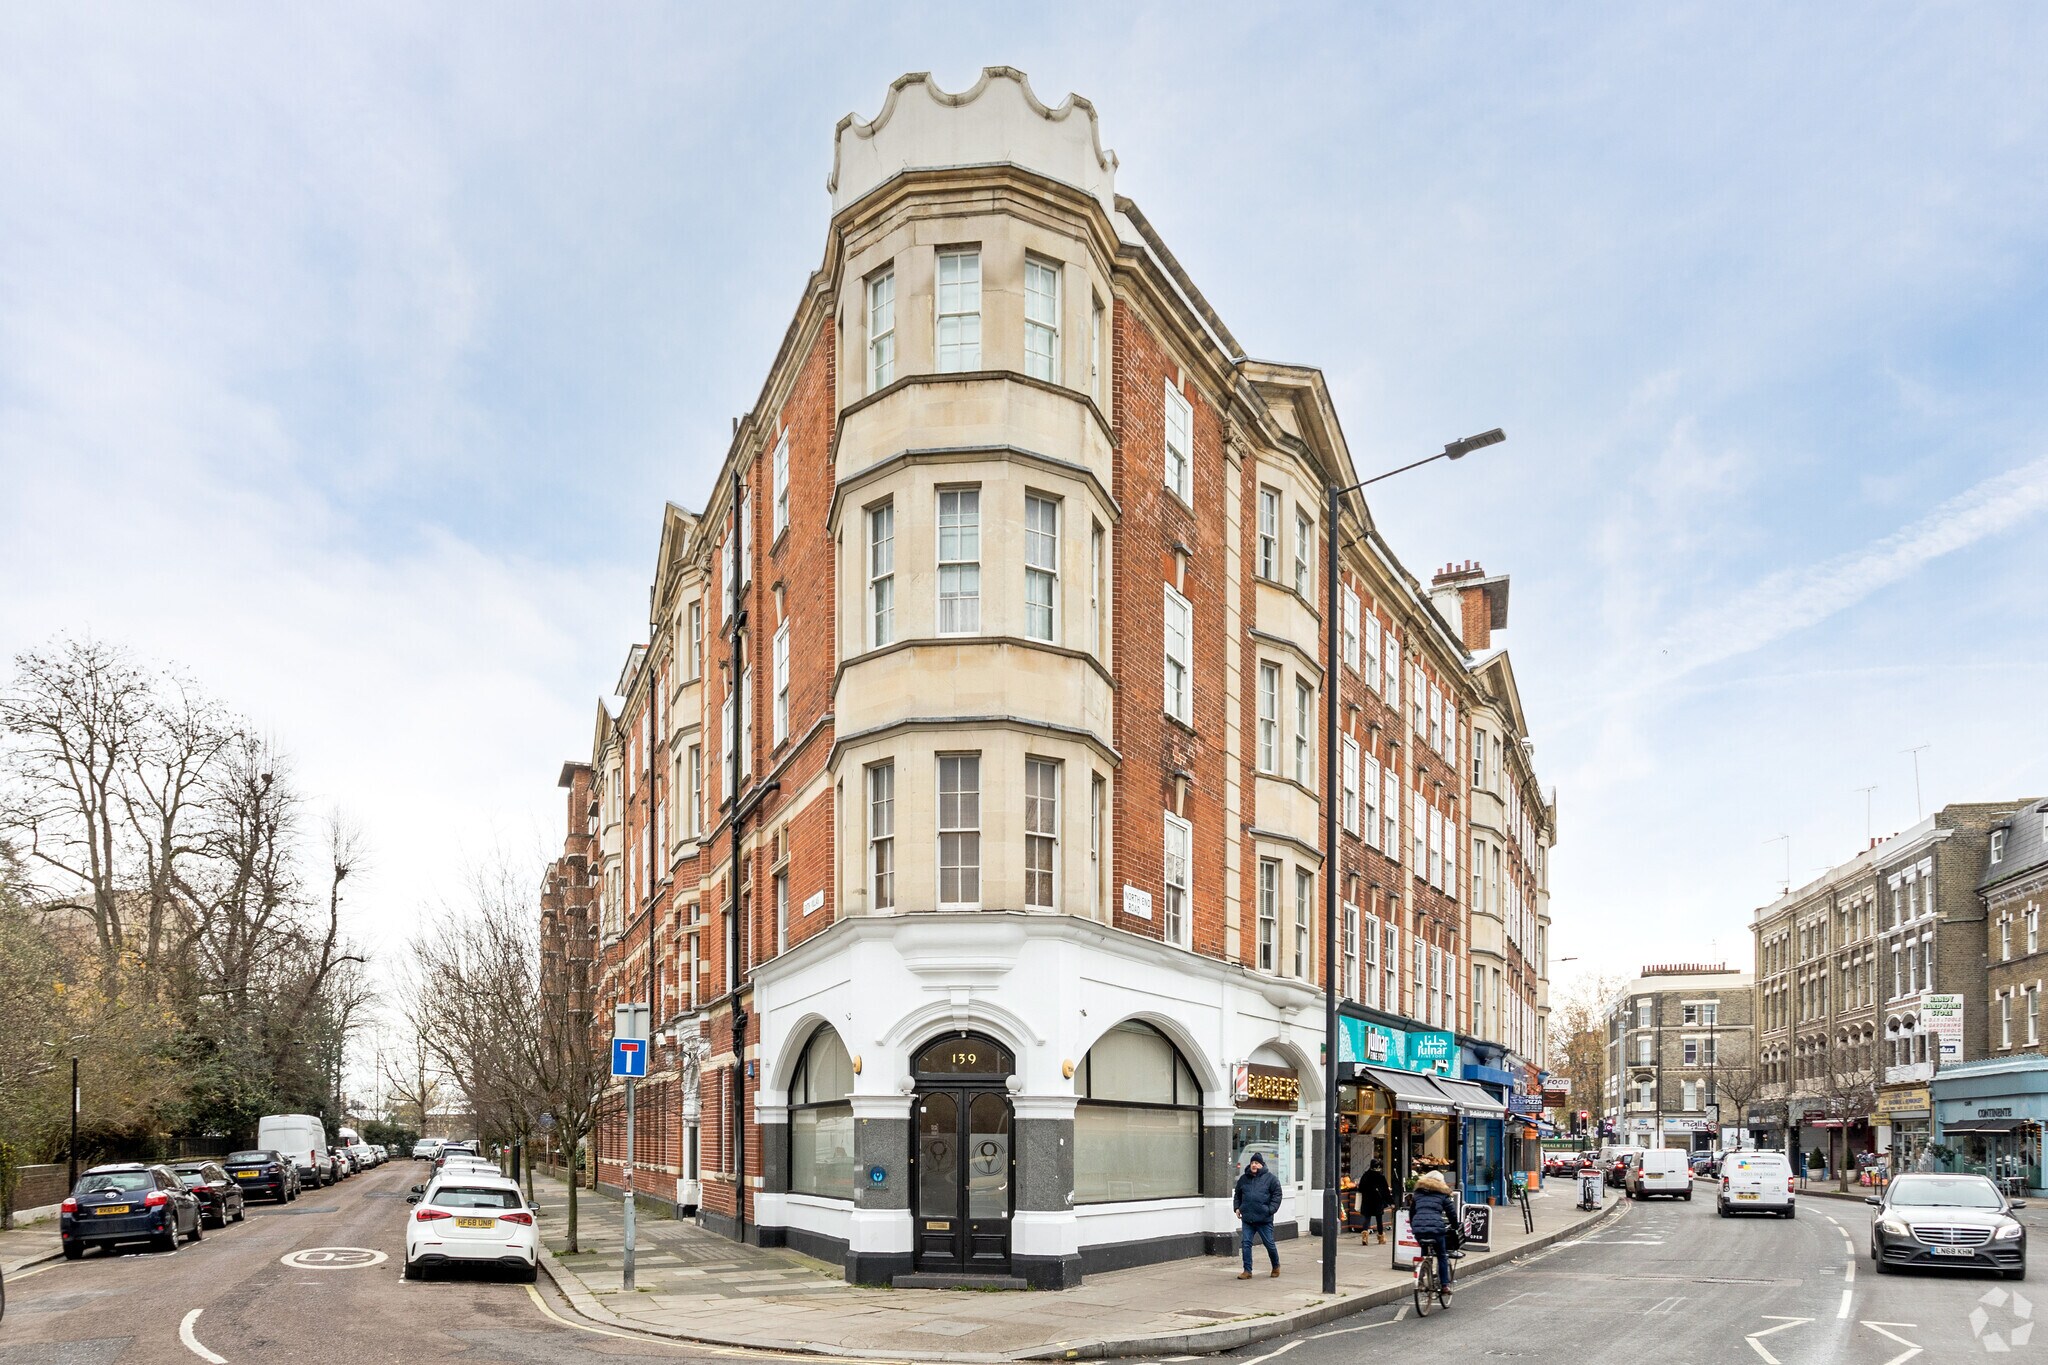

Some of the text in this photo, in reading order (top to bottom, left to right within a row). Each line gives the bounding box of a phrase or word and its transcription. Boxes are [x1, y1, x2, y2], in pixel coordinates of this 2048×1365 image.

[1125, 891, 1150, 908] NORTH END
[1128, 903, 1140, 914] ROAD
[952, 1053, 977, 1065] 139
[1370, 1052, 1378, 1061] FINE
[1248, 1073, 1299, 1101] BARBERS
[1977, 1108, 2012, 1118] CONTINENTE
[1682, 1119, 1708, 1129] nails
[114, 1205, 127, 1213] PCF
[457, 1219, 493, 1227] HF68 UNR
[1935, 1247, 1956, 1255] LN68
